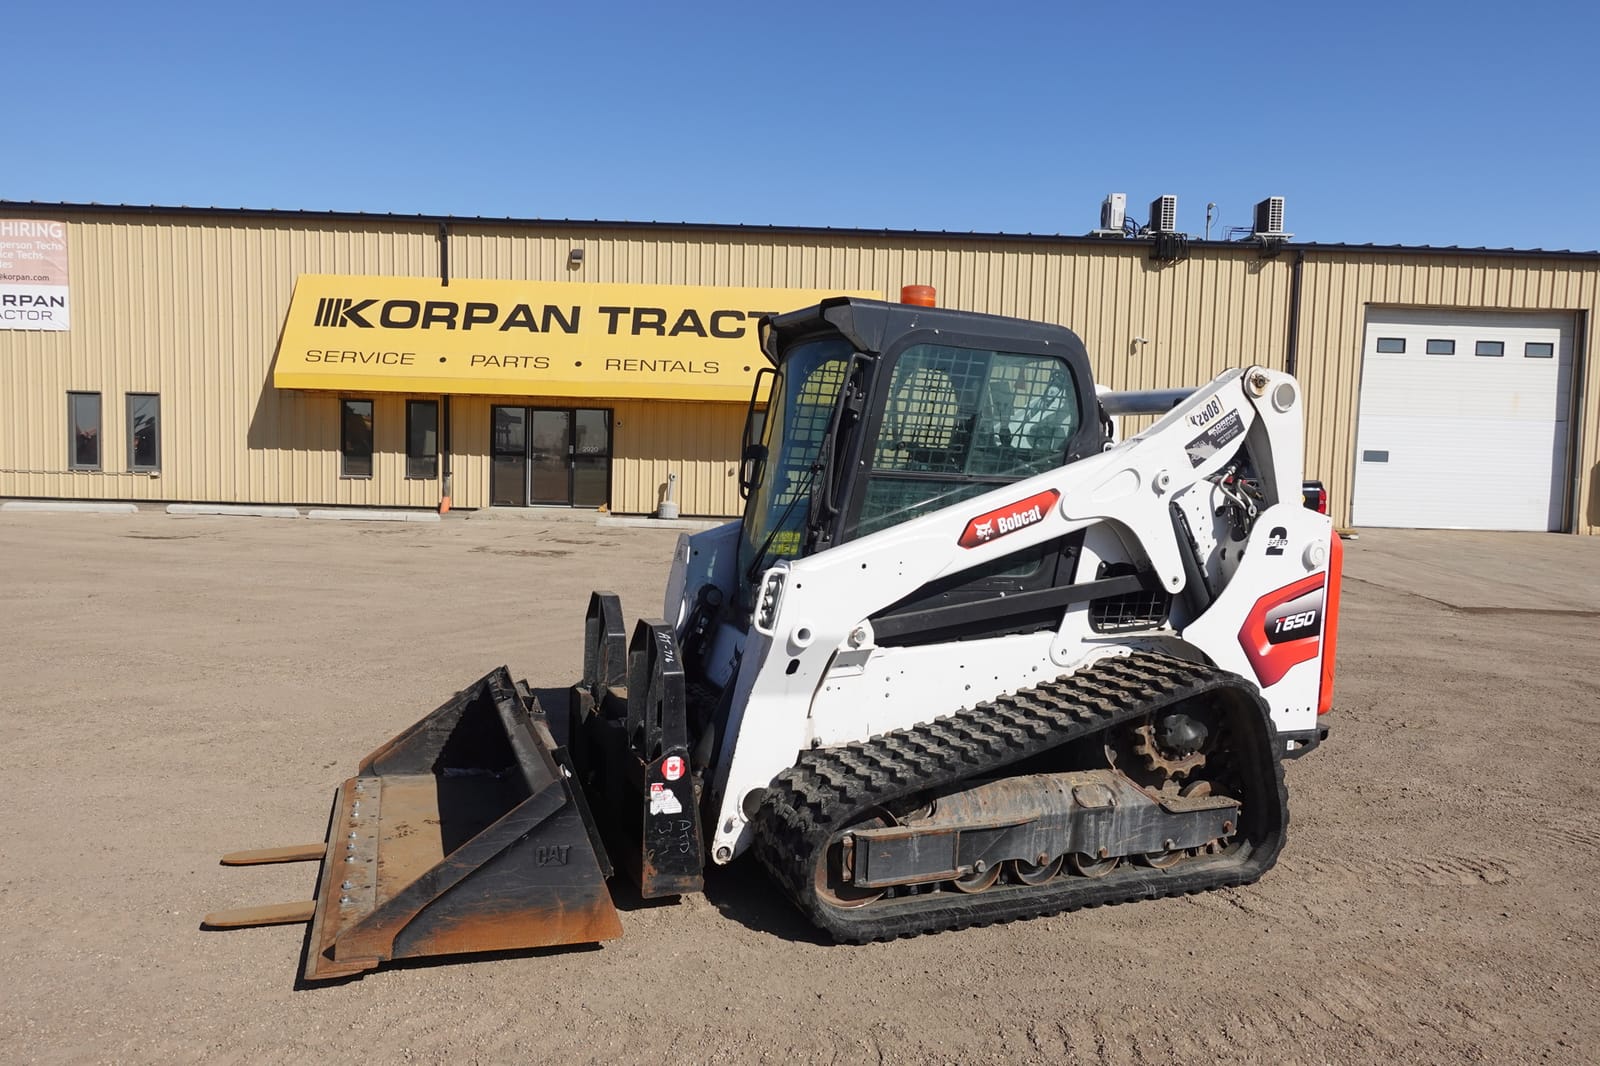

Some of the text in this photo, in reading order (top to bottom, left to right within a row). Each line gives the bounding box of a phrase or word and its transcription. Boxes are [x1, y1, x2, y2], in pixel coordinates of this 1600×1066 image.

[1, 221, 63, 238] HIRING
[16, 250, 46, 260] Techs
[35, 240, 65, 251] Techs
[2, 294, 65, 308] RPAN
[313, 297, 581, 334] KORPAN
[305, 349, 720, 374] SERVICE PARTS RENTALS
[997, 504, 1042, 534] Bobcat
[1265, 526, 1288, 556] 2
[1267, 539, 1289, 547] SPEED
[1274, 610, 1316, 634] T650
[535, 844, 570, 867] CAT
